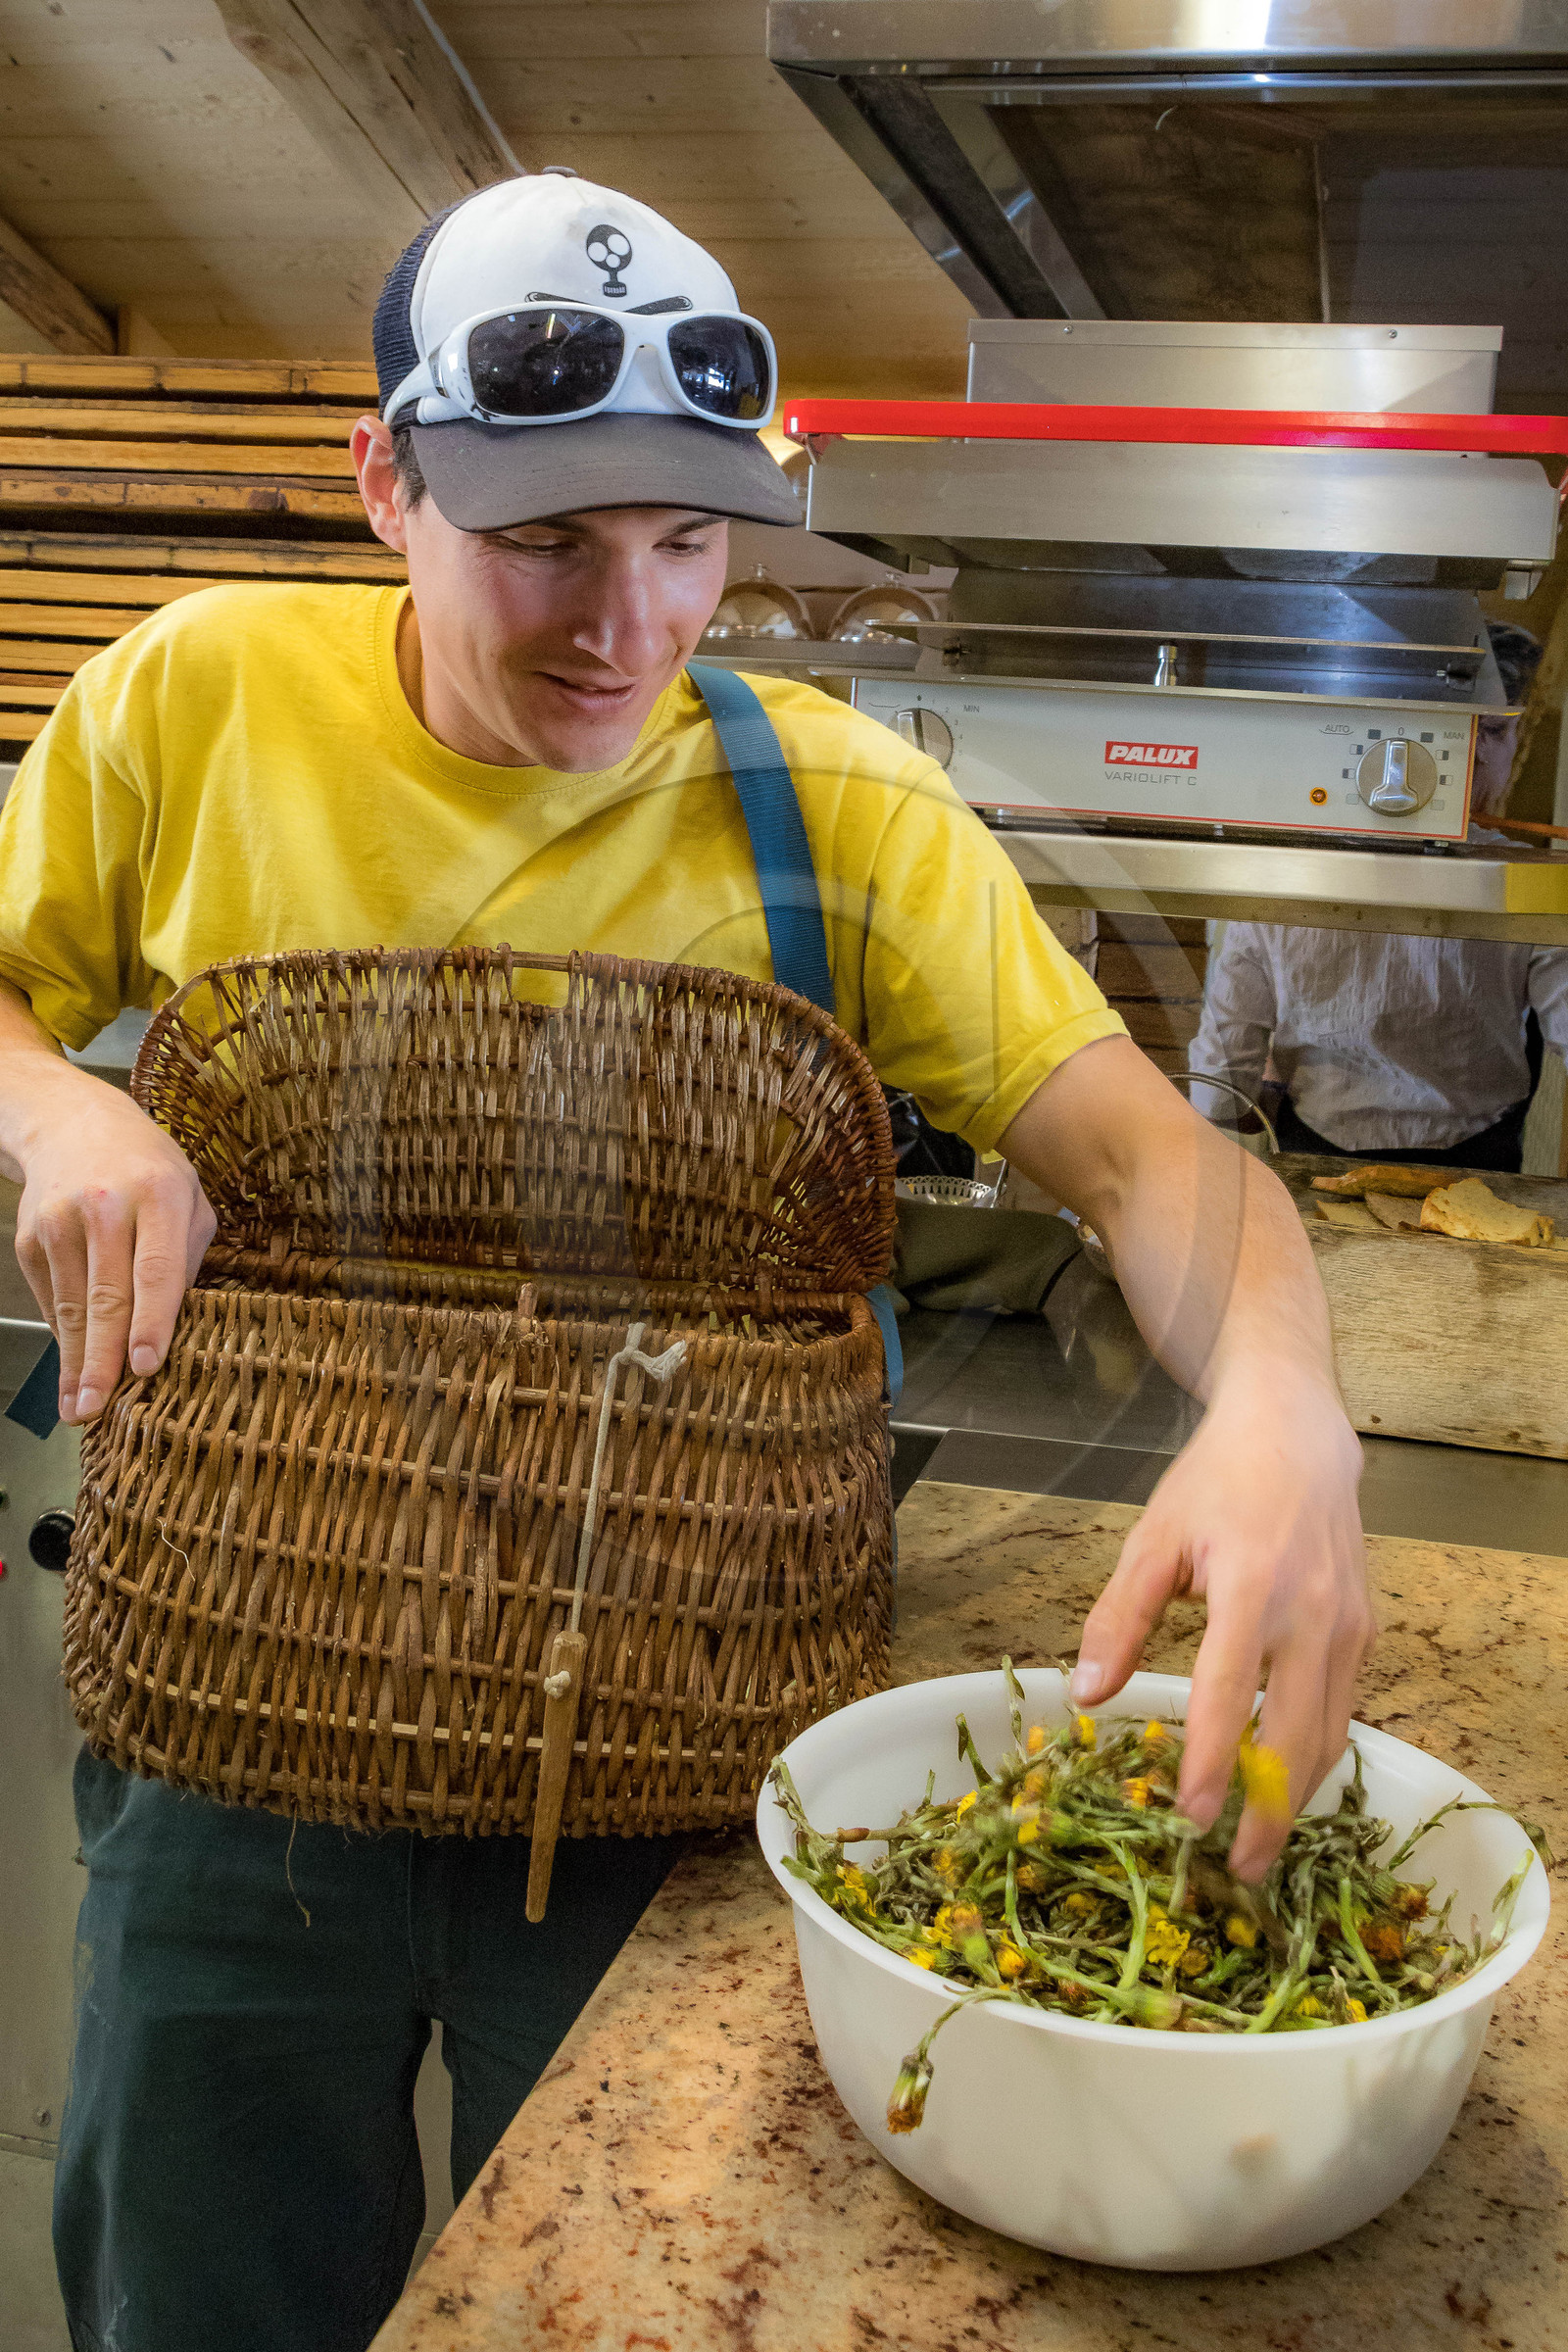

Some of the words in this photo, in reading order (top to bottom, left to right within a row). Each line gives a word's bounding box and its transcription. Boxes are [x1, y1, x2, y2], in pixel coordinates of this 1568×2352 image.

[963, 704, 980, 713] MIN
[1325, 723, 1350, 733] AUTO
[1444, 731, 1465, 740] MAN
[1107, 744, 1196, 766] PALUX
[1104, 770, 1181, 785] VARIOLIFT
[1187, 776, 1198, 786] C
